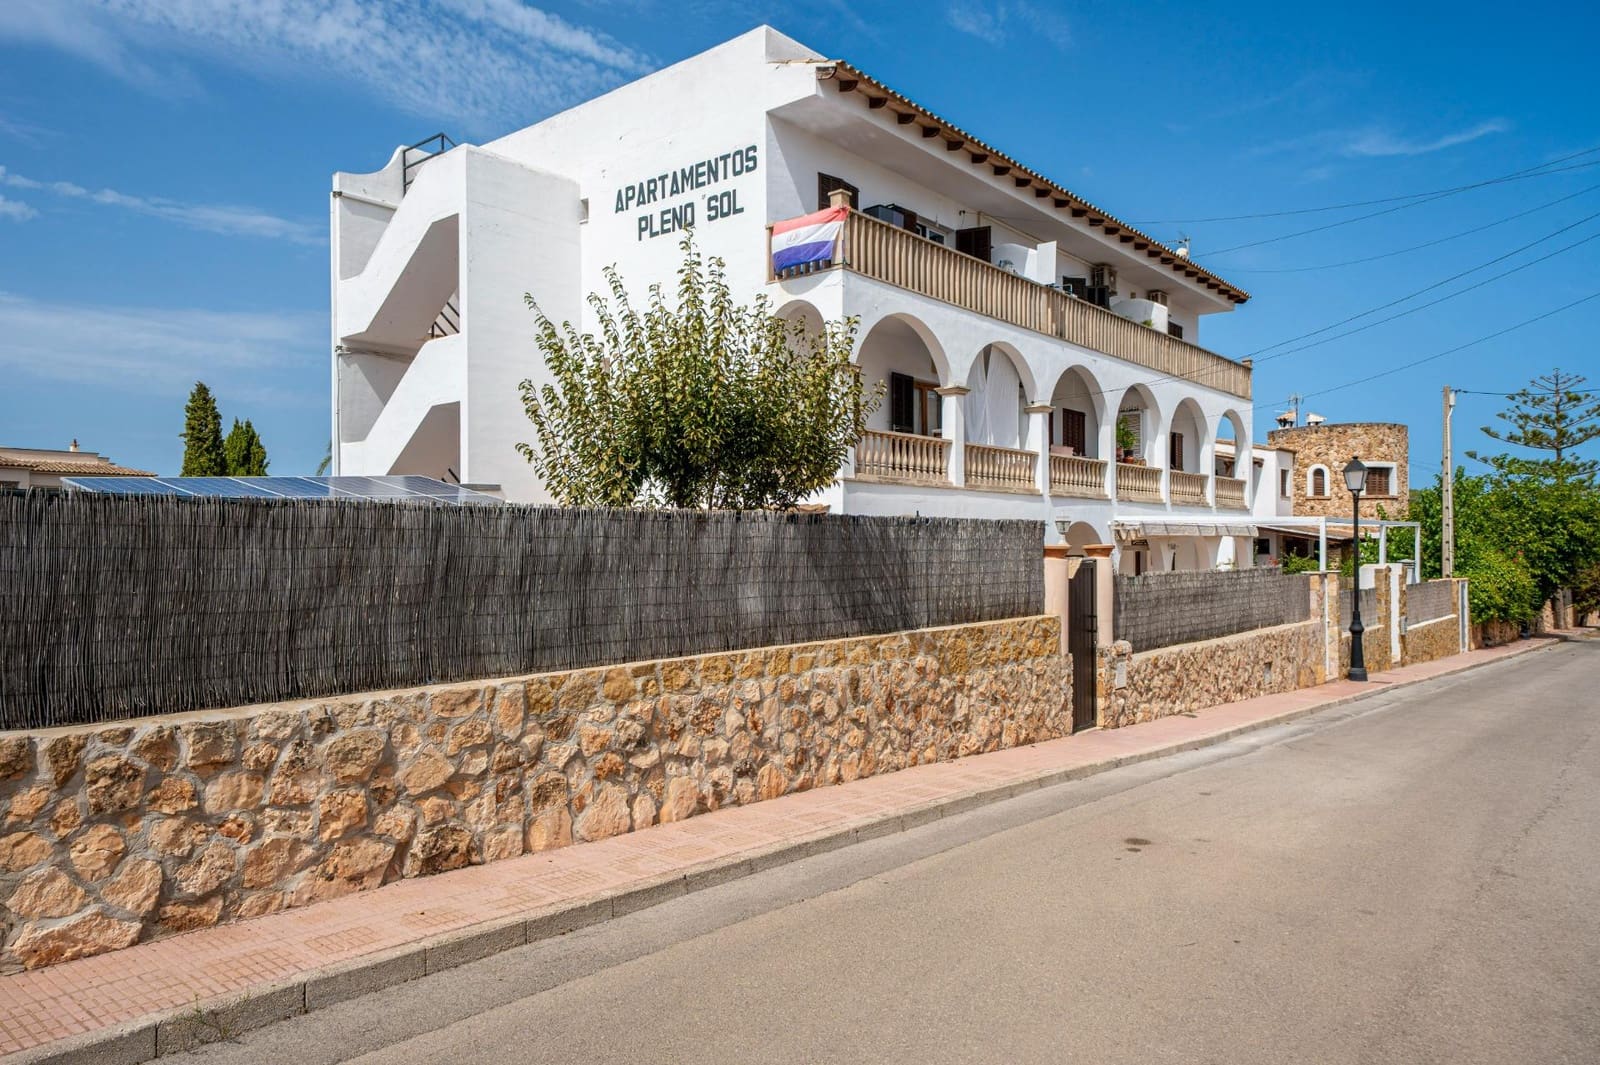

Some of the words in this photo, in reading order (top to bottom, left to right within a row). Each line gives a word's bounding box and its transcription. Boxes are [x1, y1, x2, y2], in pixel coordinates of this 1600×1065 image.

[615, 144, 758, 214] APARTAMENTOS
[638, 201, 695, 241] PLENO
[707, 189, 744, 222] SOL
